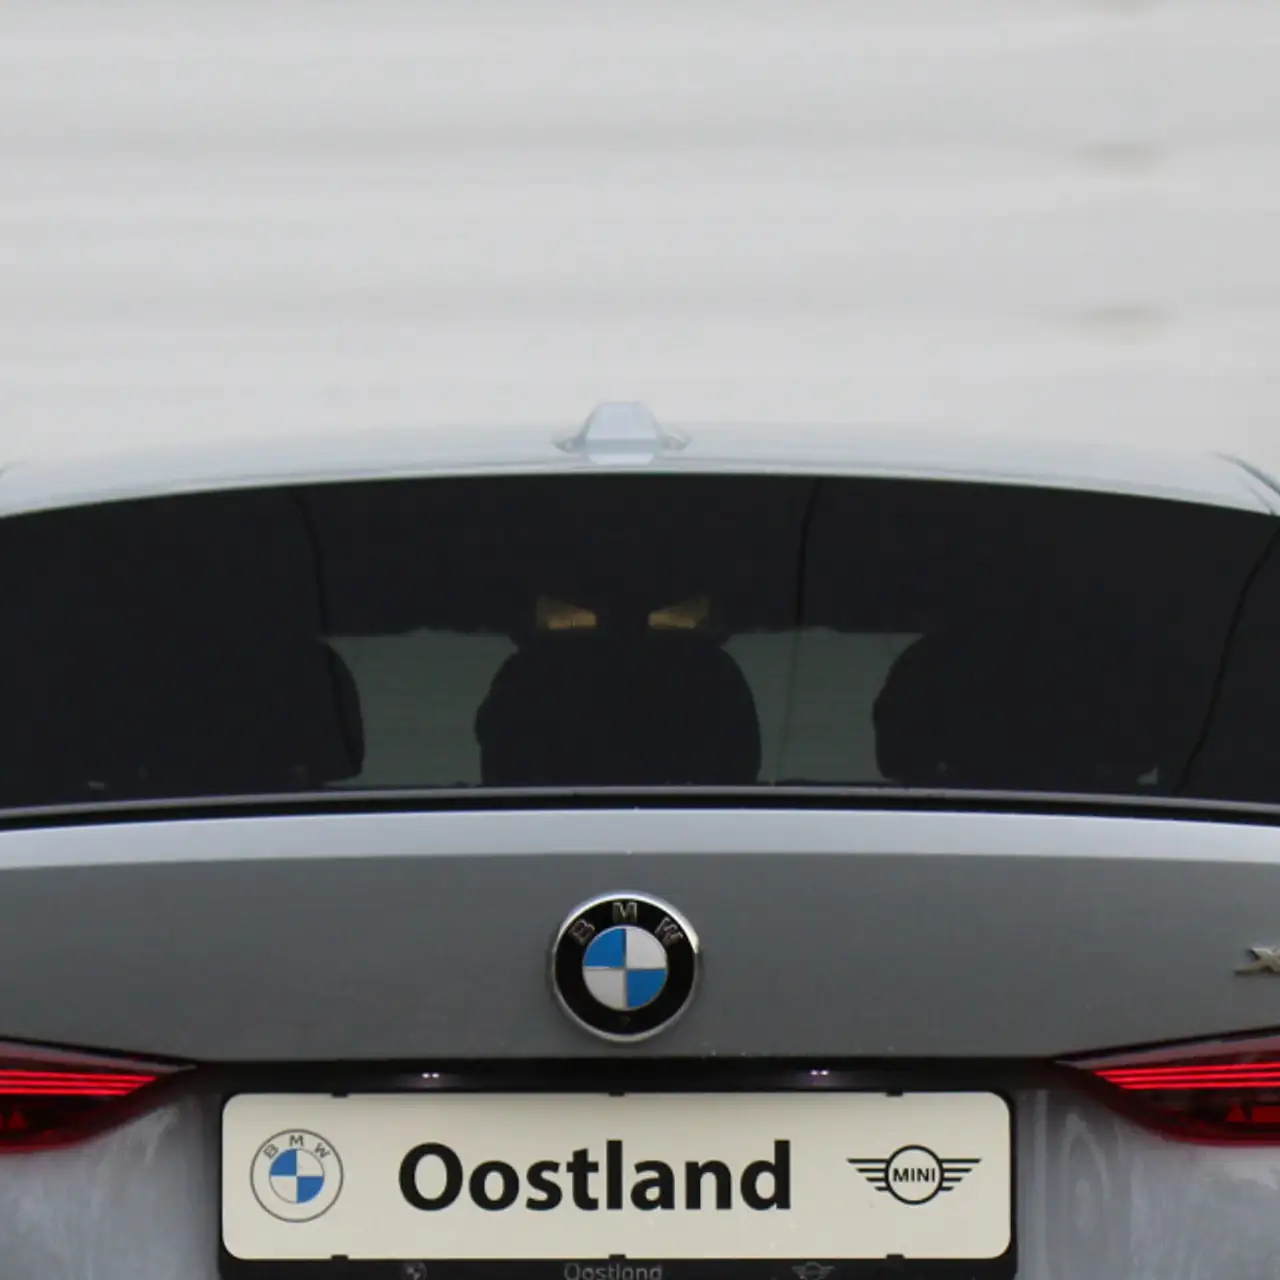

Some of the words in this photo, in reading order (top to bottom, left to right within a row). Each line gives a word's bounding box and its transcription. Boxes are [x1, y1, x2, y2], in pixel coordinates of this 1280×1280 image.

[569, 901, 683, 946] BMW
[263, 1134, 331, 1160] BMW
[398, 1139, 791, 1211] Oostland
[892, 1167, 936, 1183] MINI
